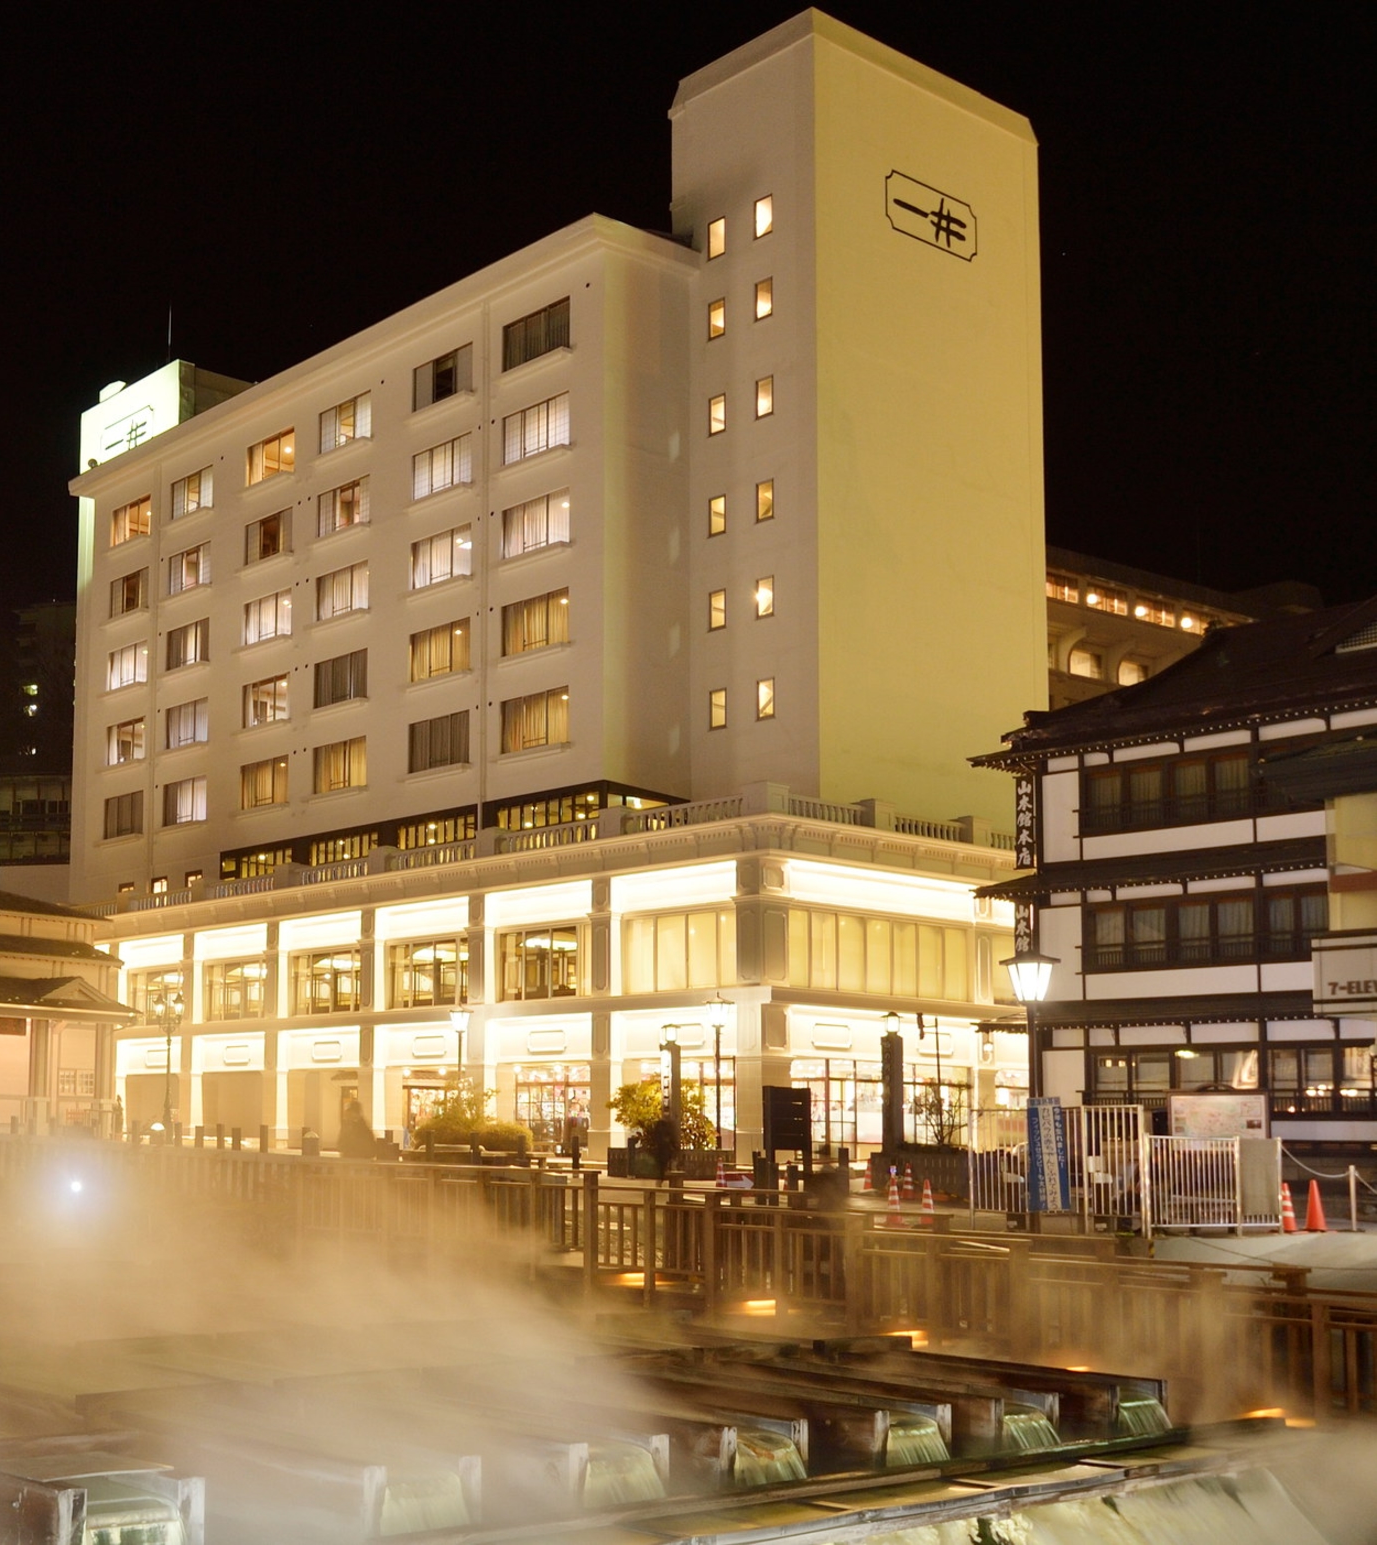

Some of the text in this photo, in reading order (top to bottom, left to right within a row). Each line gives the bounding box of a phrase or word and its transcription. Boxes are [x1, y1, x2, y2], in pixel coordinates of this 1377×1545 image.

[892, 197, 967, 248] 一井
[1017, 780, 1033, 867] 山本館本店
[1016, 904, 1030, 952] 山本館
